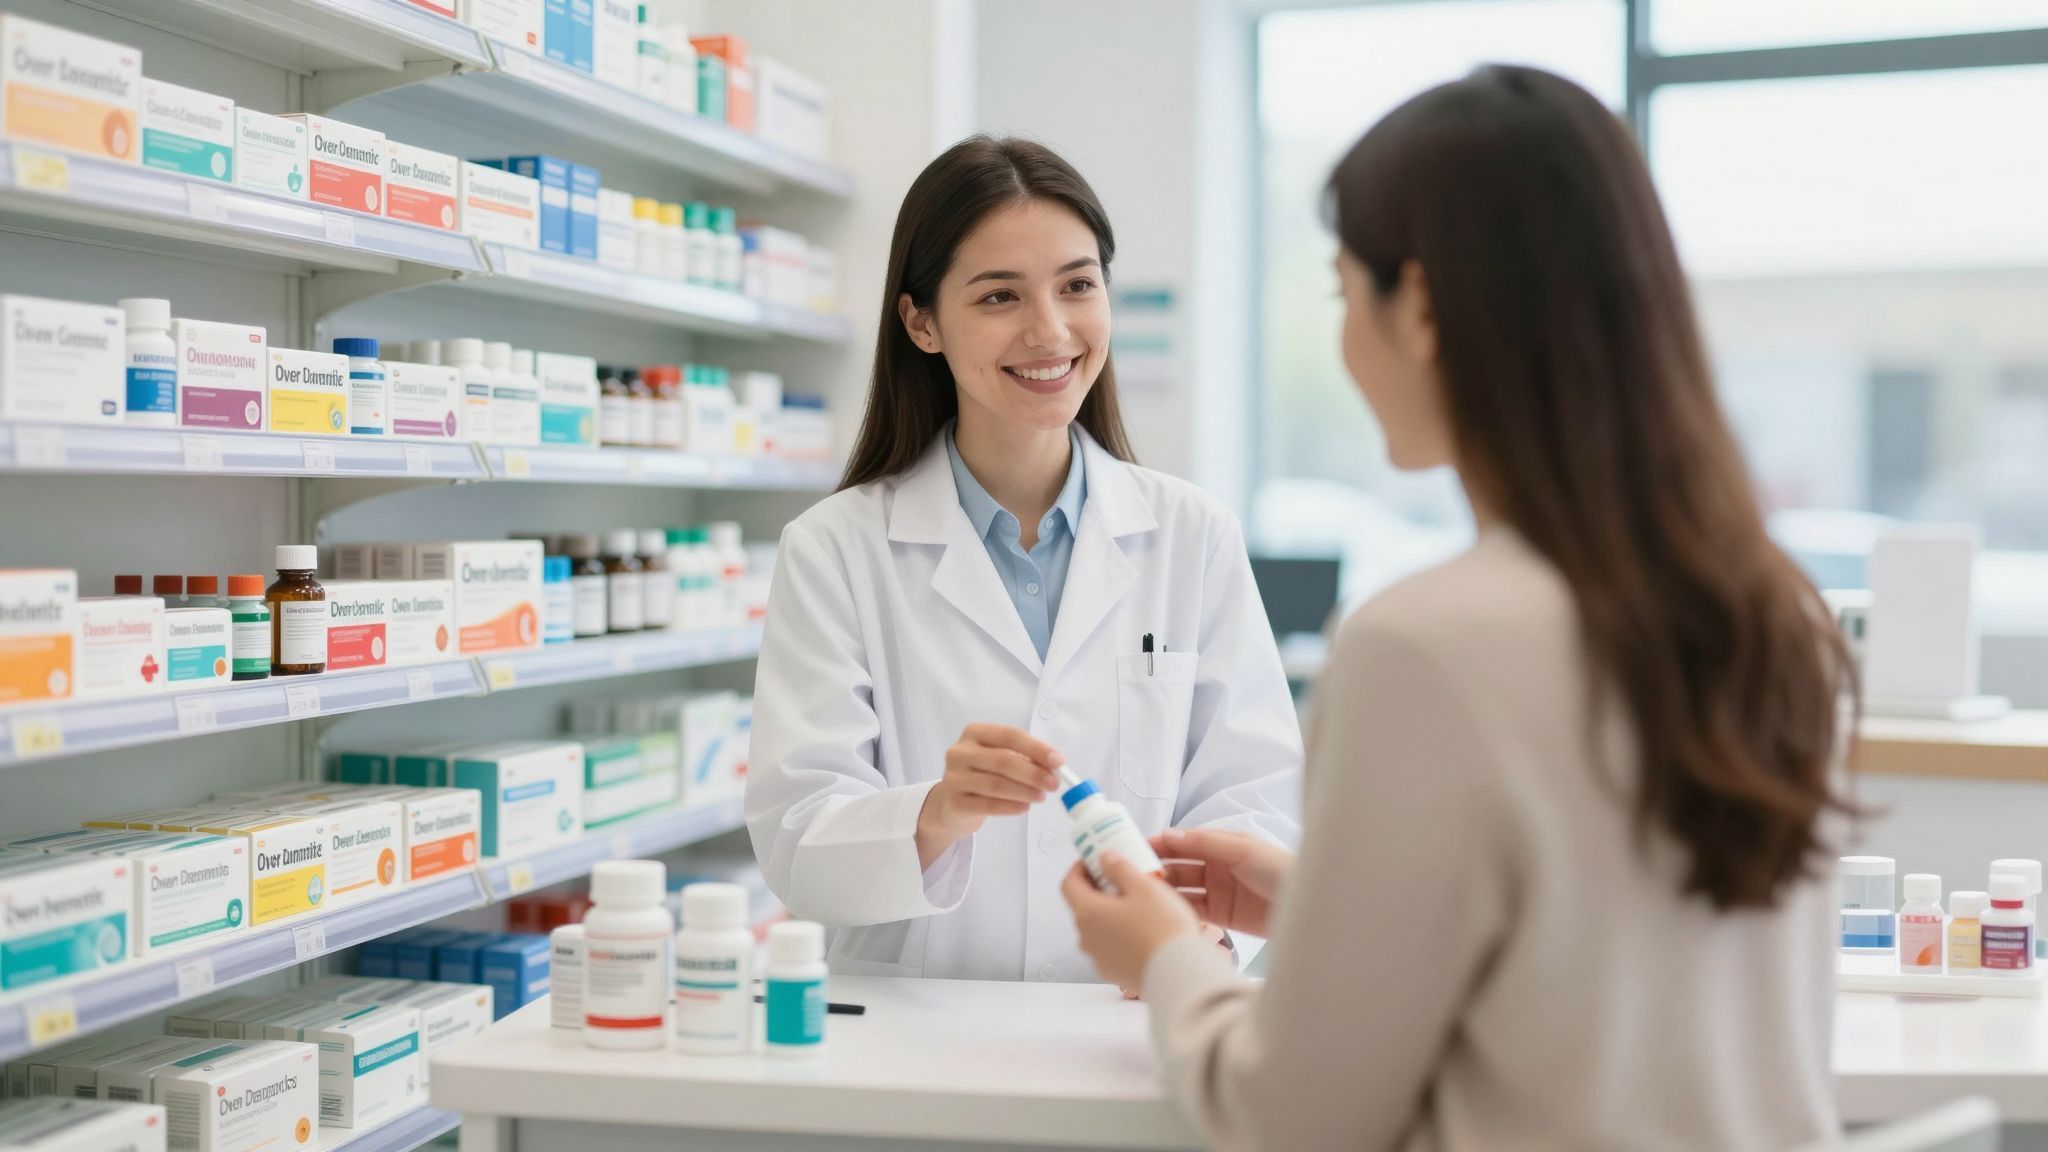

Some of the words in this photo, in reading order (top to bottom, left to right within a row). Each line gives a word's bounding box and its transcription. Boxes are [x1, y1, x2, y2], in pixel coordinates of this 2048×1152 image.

[315, 134, 338, 154] Over
[275, 364, 300, 383] Over
[258, 852, 281, 871] Over
